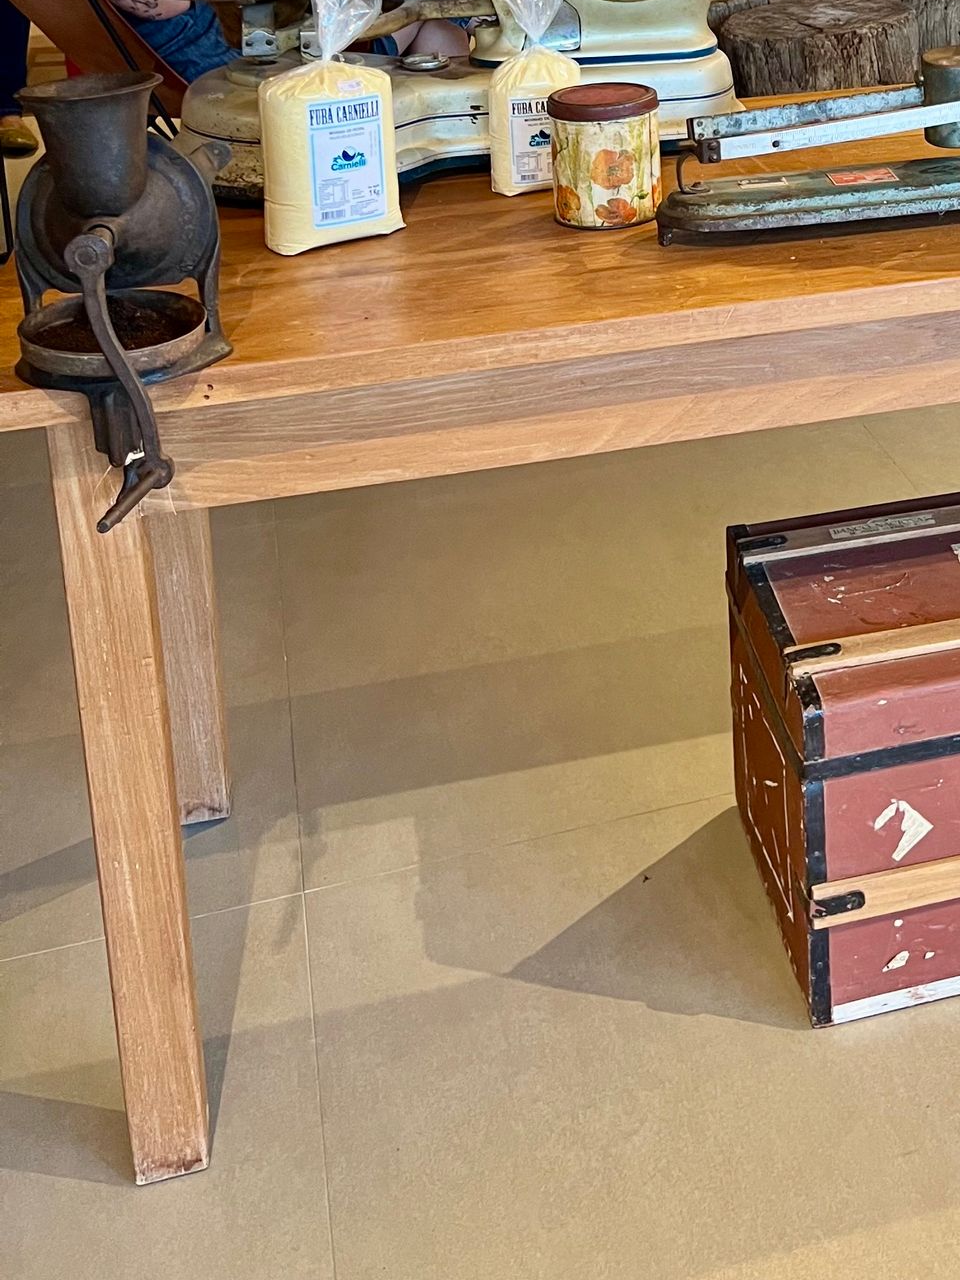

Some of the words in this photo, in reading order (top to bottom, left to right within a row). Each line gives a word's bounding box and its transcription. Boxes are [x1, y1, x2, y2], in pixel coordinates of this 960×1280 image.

[309, 105, 334, 126] FUBÁ
[336, 100, 379, 124] CARNIELLI
[331, 158, 367, 171] Carnielli
